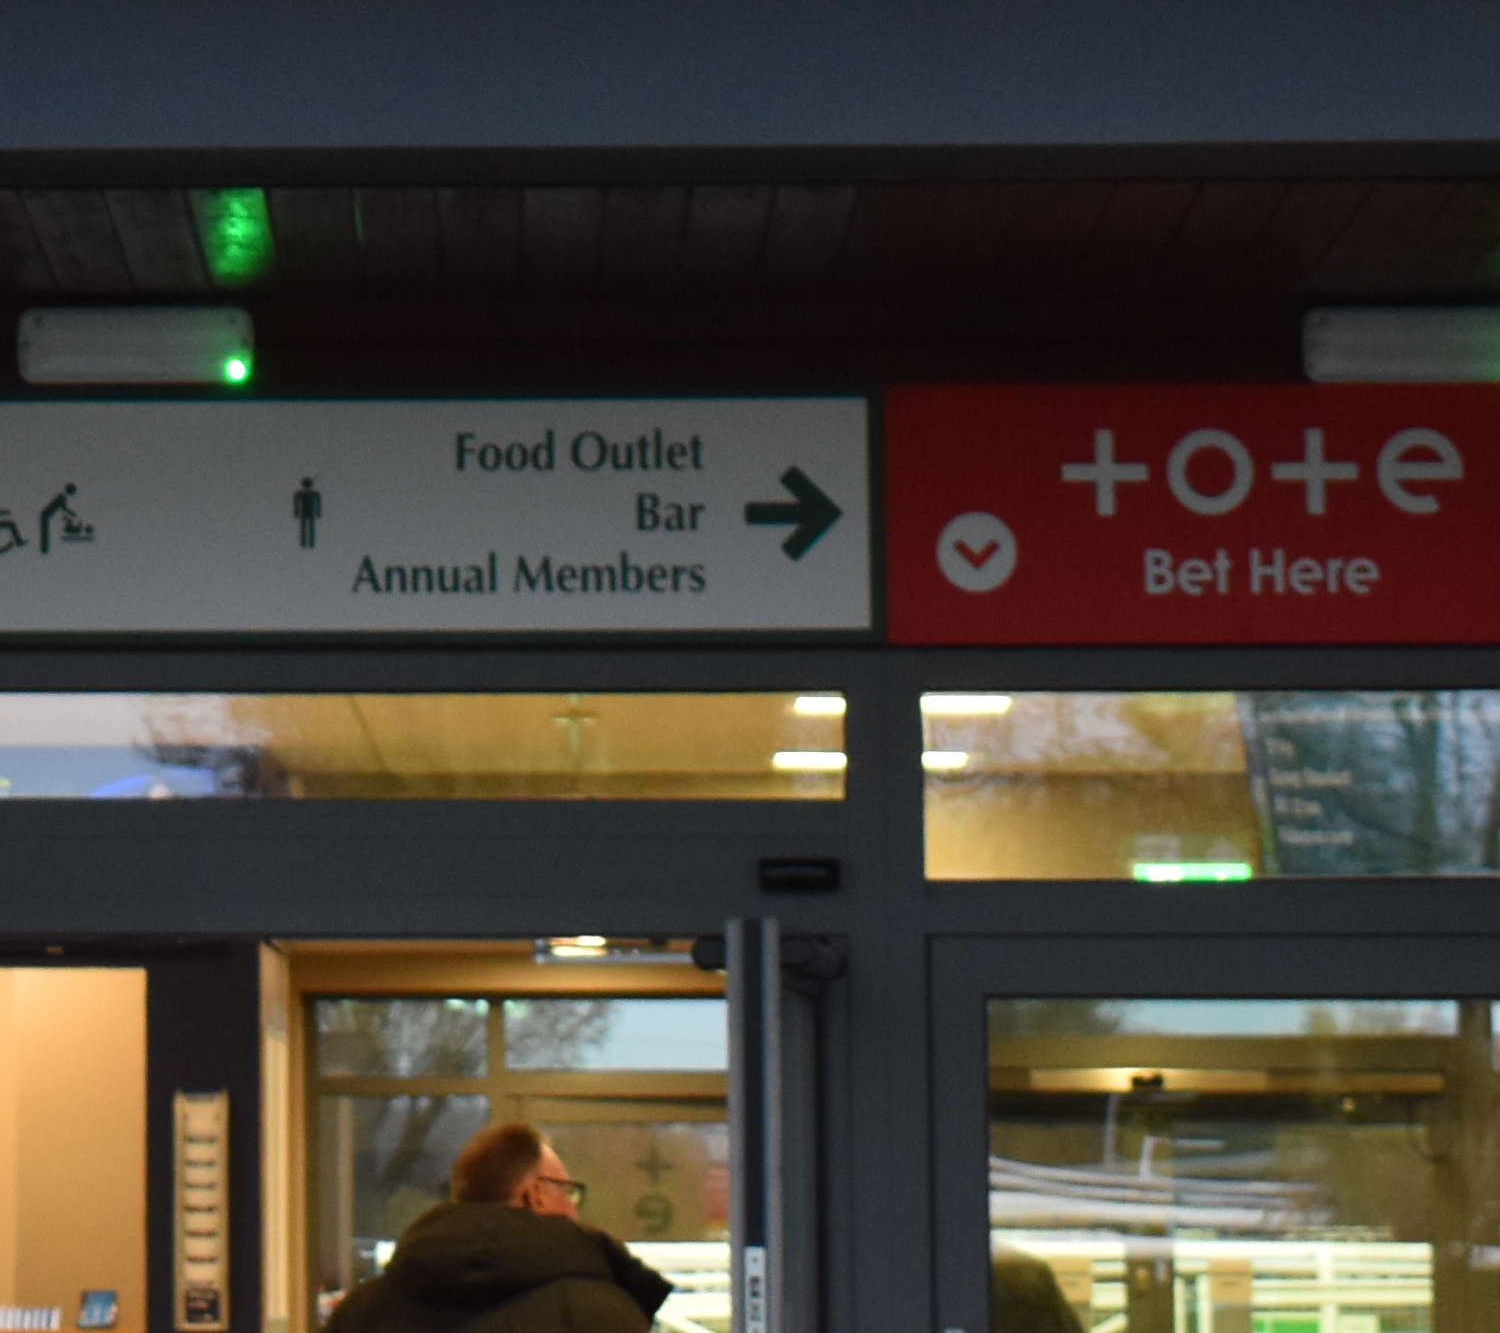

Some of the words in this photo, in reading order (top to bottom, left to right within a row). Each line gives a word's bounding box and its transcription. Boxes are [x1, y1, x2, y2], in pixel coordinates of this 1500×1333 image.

[455, 428, 555, 471] Food
[570, 428, 704, 471] Outlet
[636, 492, 705, 532] Bar
[353, 550, 498, 593] Annual
[514, 550, 706, 594] Members
[1143, 548, 1232, 595] Bet
[1248, 548, 1381, 596] Here
